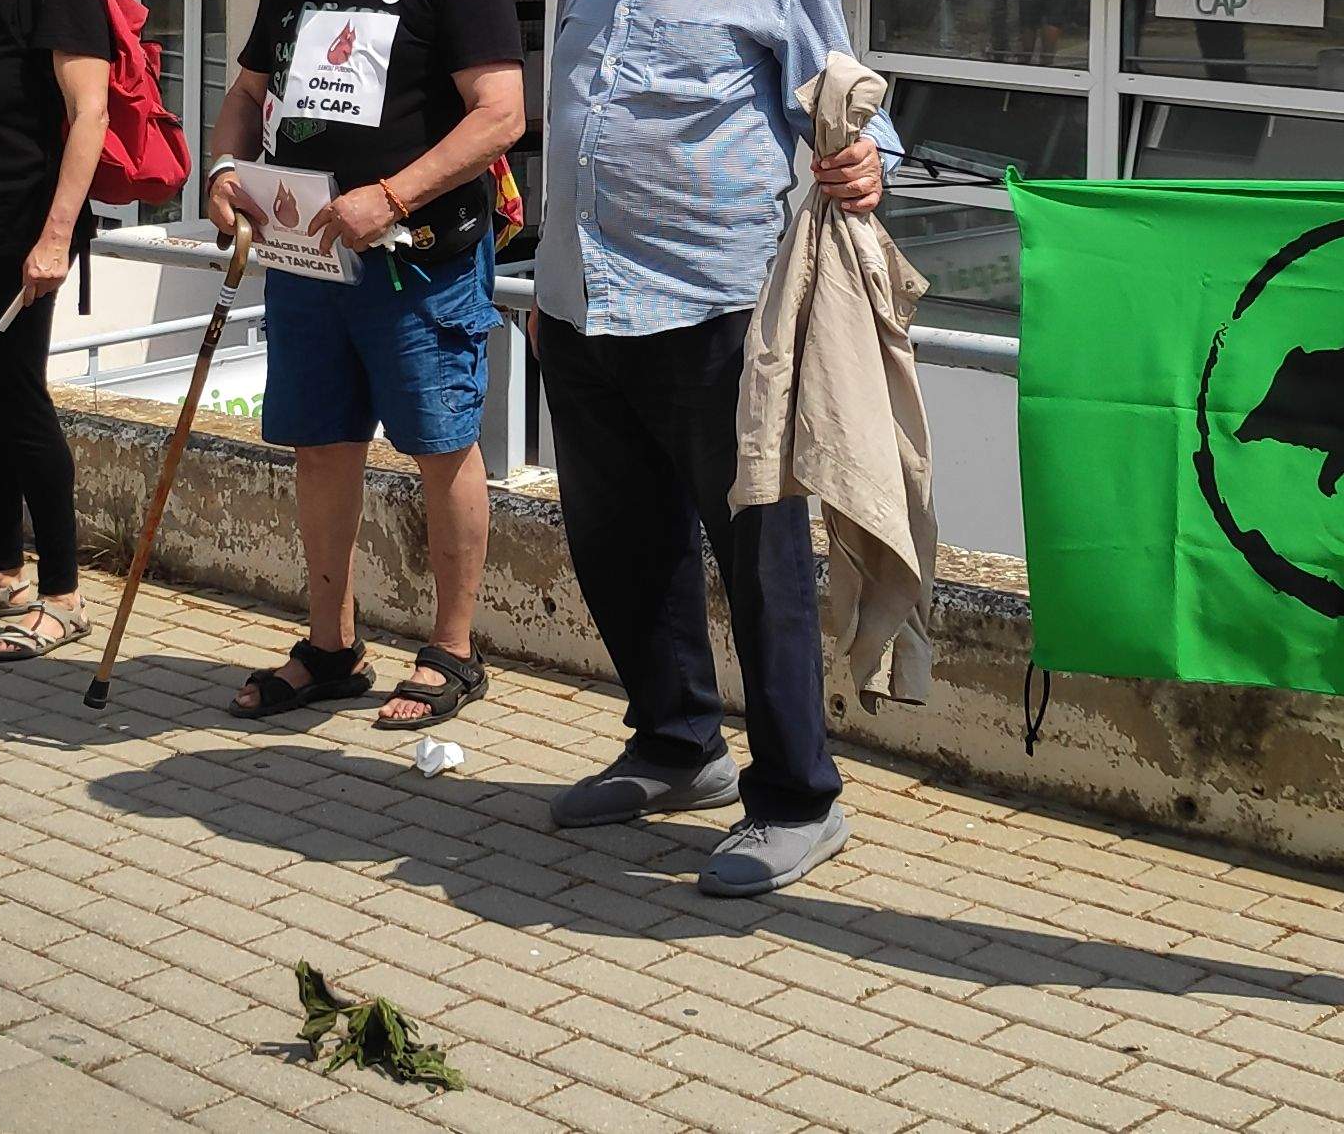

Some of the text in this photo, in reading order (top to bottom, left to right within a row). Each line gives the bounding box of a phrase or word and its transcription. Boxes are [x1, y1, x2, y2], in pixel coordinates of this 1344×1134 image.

[308, 77, 355, 94] Obrim
[296, 96, 361, 116] els CAPs
[257, 248, 341, 274] CAPs TANCATS
